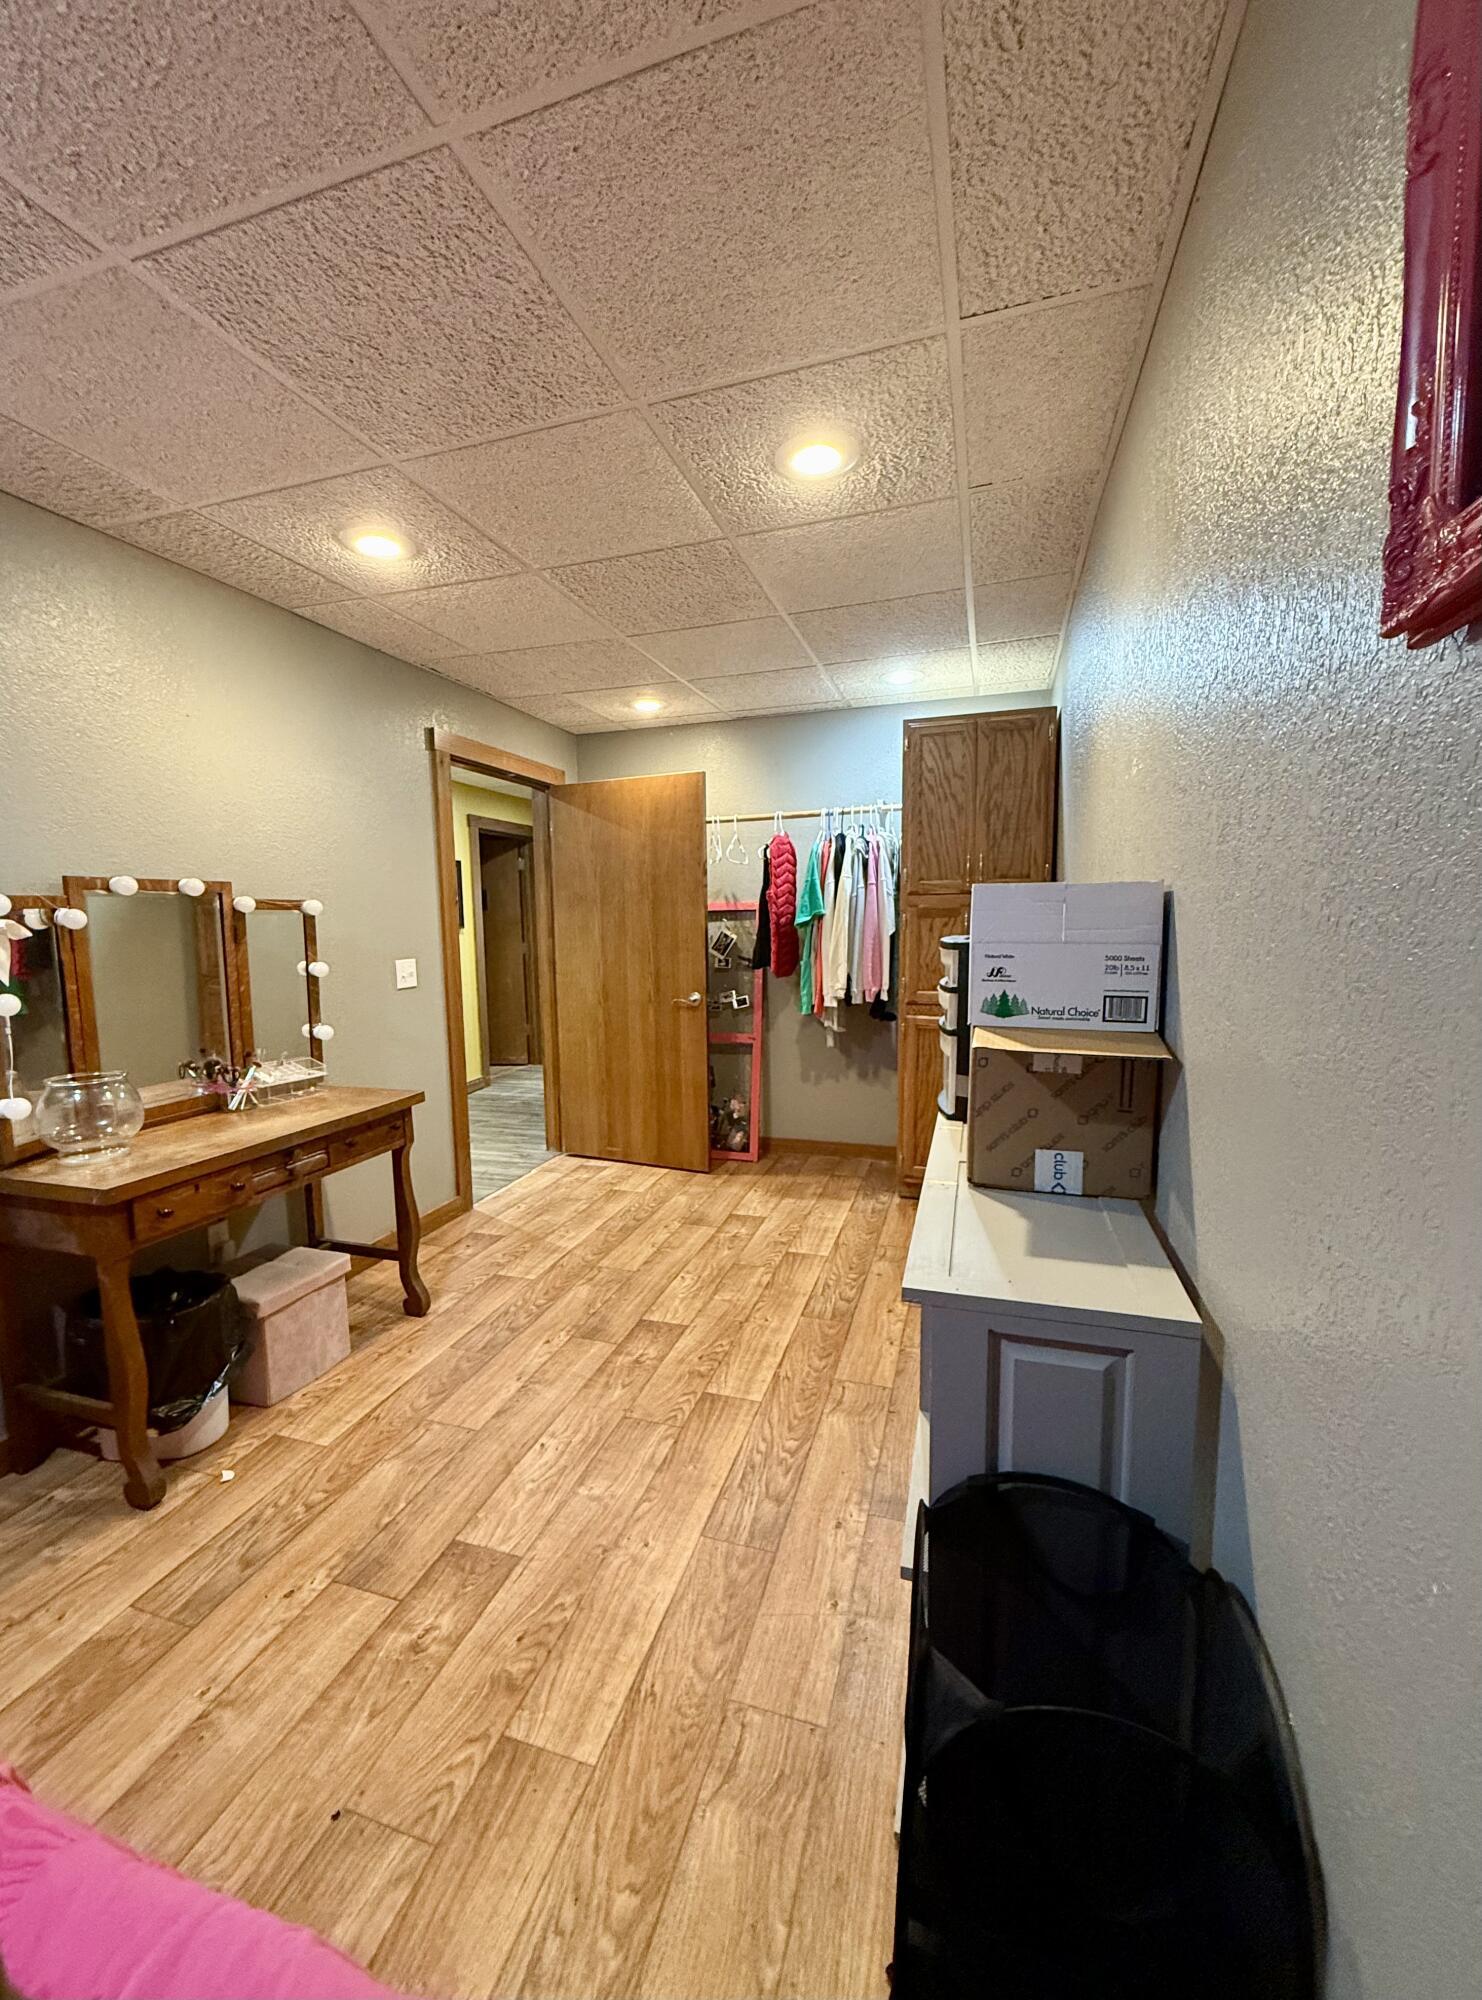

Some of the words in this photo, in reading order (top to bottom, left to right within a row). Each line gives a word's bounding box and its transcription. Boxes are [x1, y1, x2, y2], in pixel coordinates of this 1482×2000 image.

[1031, 1006, 1065, 1016] Natural
[1068, 1006, 1100, 1017] Choice
[1053, 1152, 1067, 1181] club
